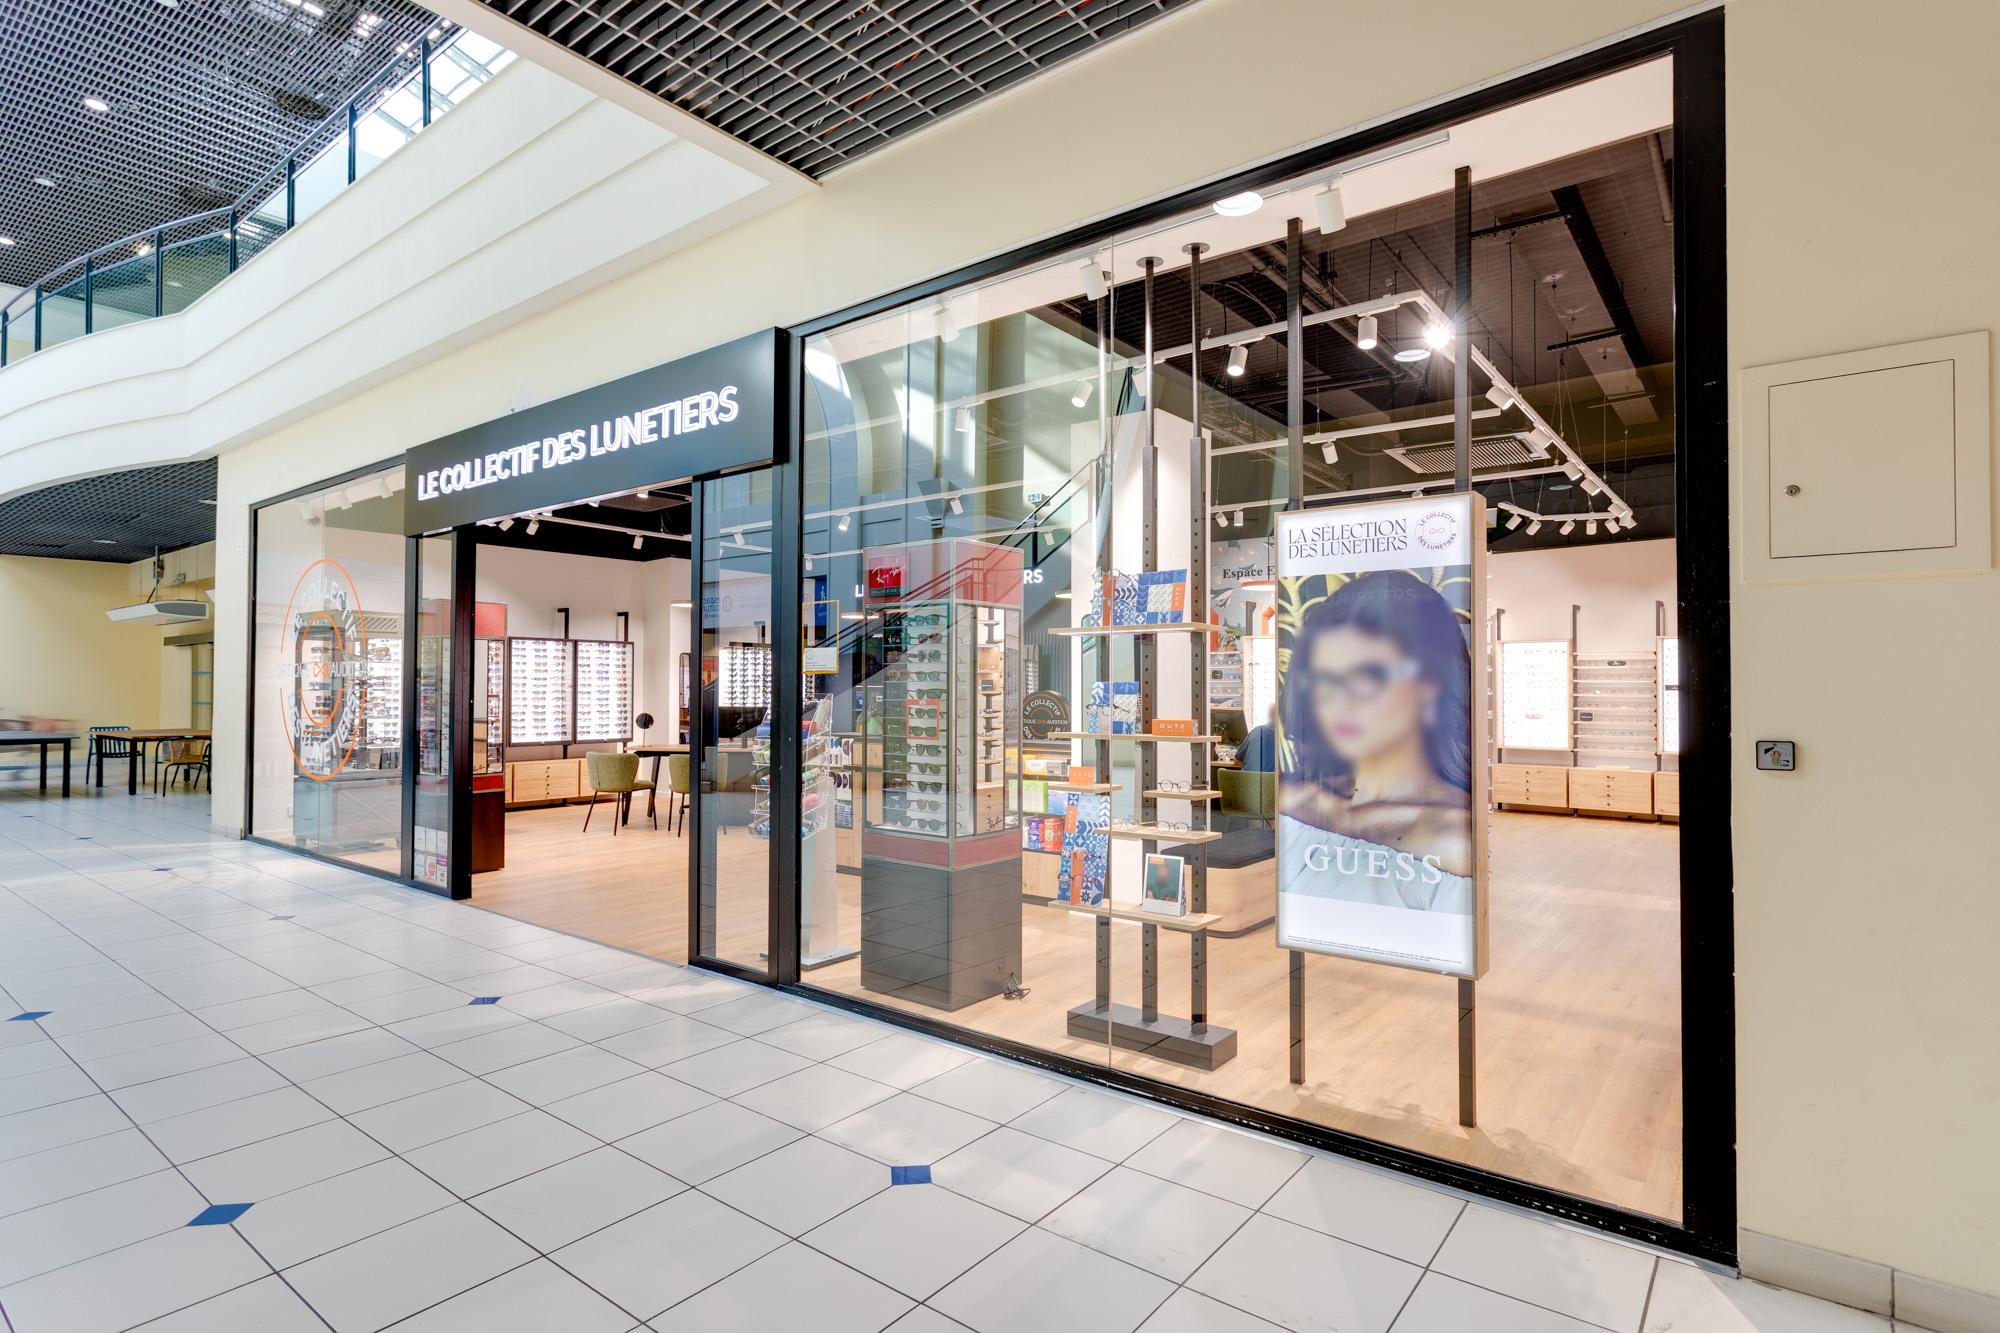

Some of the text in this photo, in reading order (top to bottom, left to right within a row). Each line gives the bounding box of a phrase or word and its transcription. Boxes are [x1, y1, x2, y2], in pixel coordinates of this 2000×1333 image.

[417, 385, 739, 502] LE COLLECTIF DES LUNETIERS
[1425, 511, 1456, 524] COLLECTIF
[1288, 518, 1407, 545] LA SÉLECTION
[1417, 532, 1457, 550] DES LUNETIERS
[1288, 535, 1408, 559] DES LUNETIERS
[1223, 568, 1263, 580] Espace
[1024, 699, 1060, 716] LE COLLECTIF
[1303, 843, 1443, 884] GUESS
